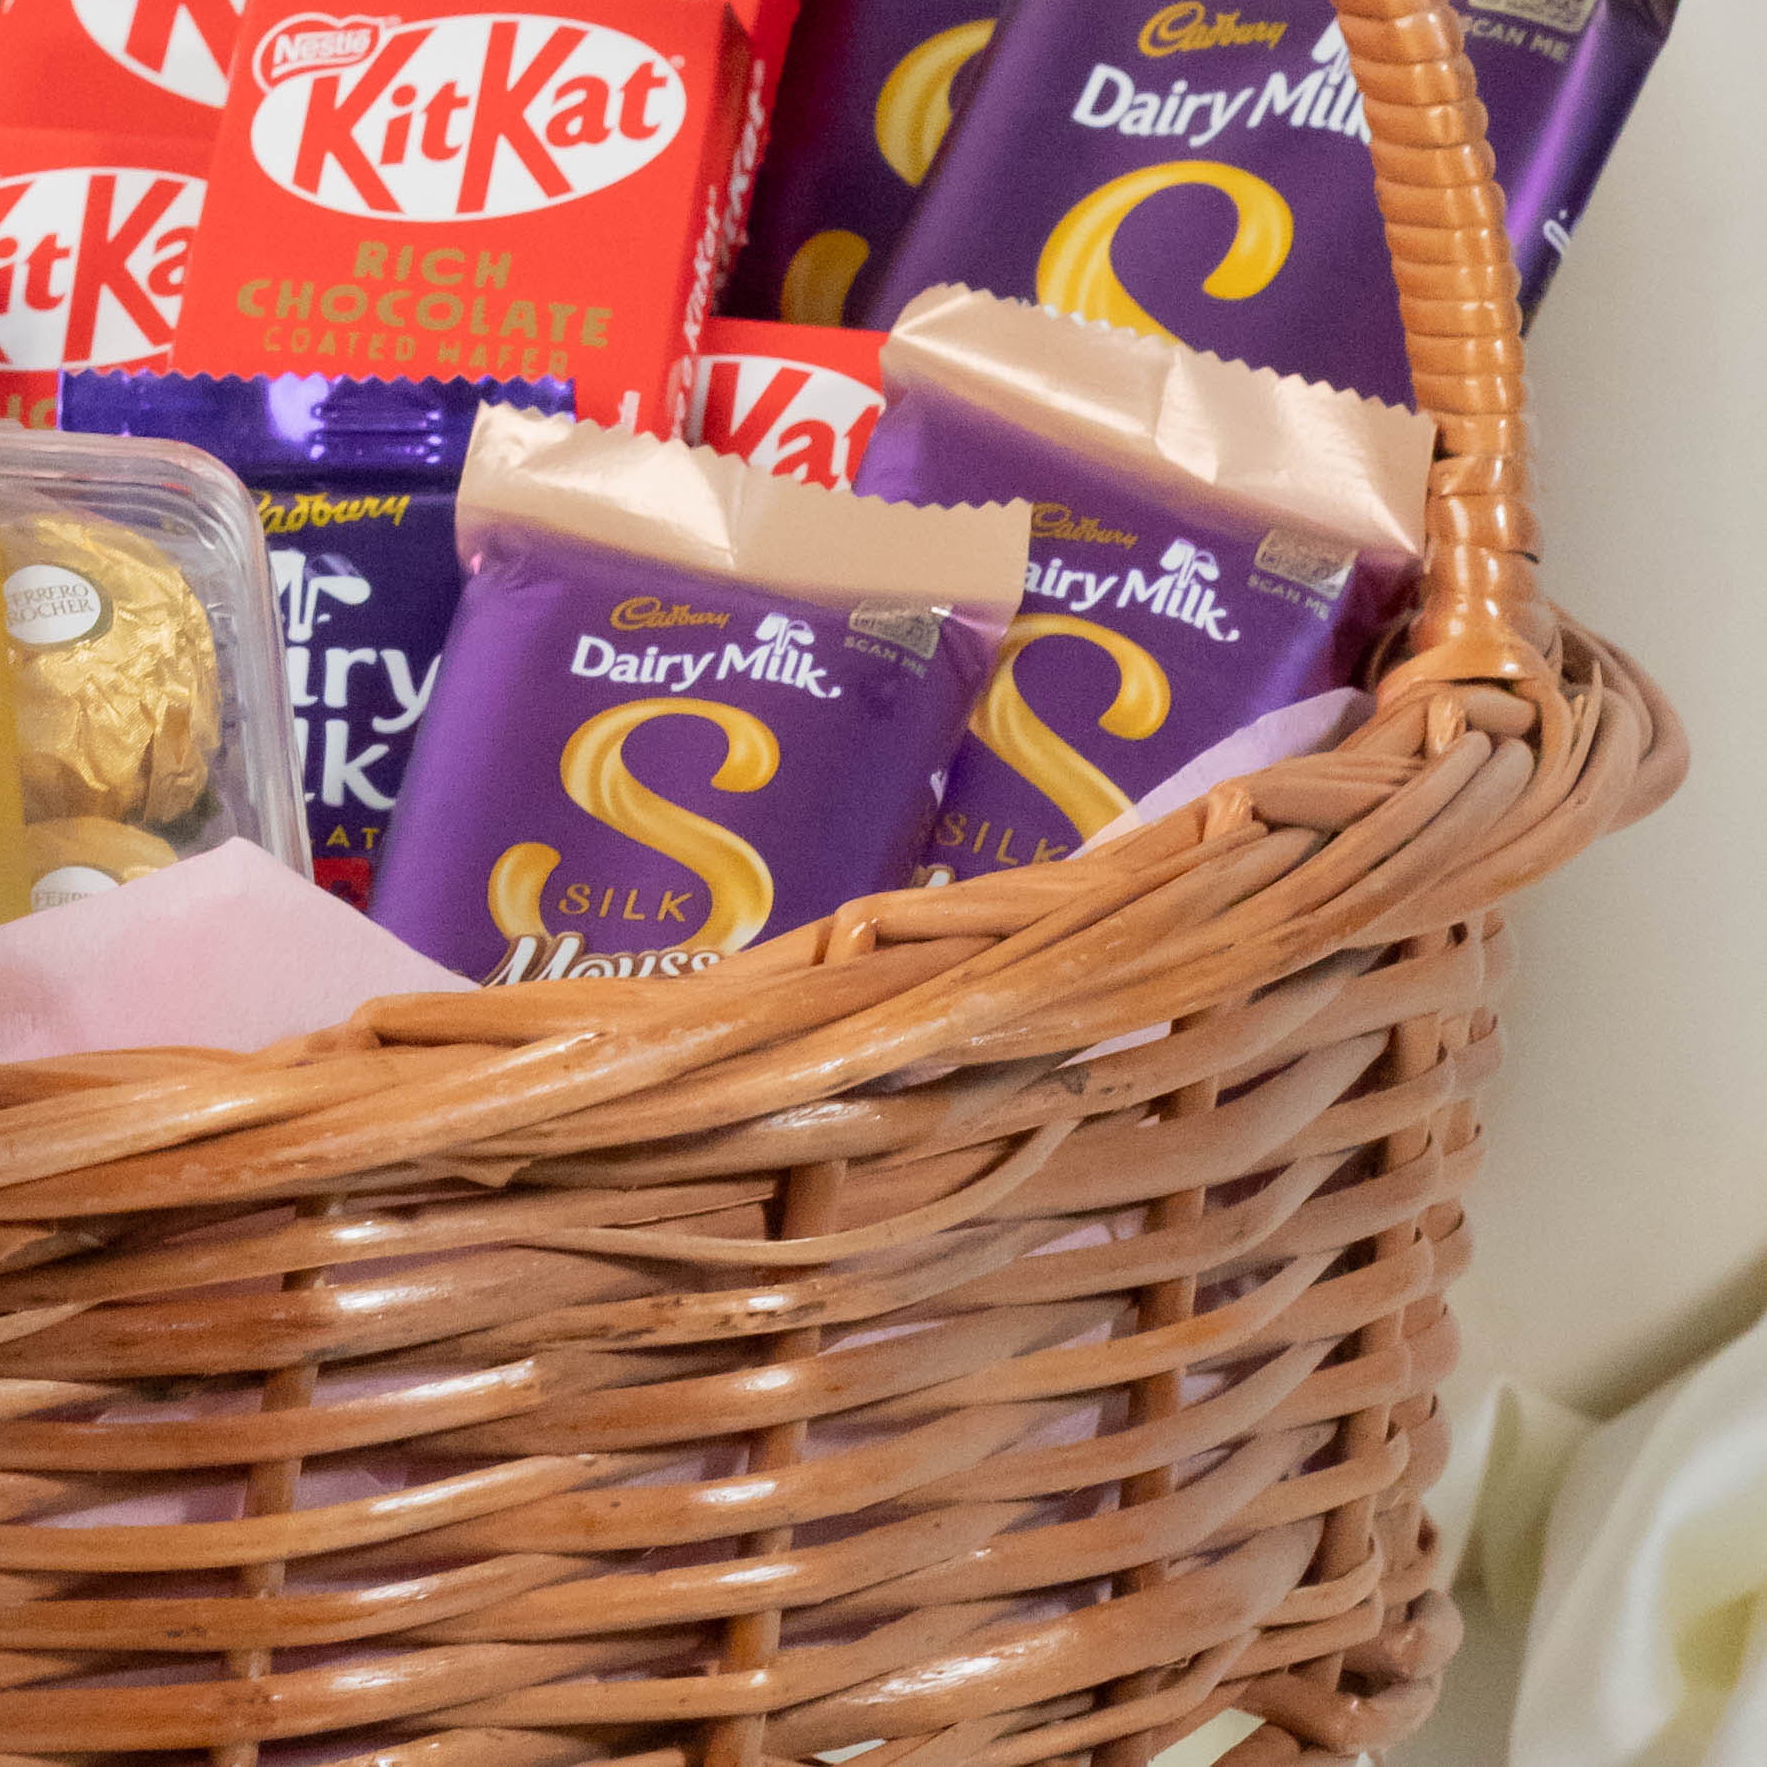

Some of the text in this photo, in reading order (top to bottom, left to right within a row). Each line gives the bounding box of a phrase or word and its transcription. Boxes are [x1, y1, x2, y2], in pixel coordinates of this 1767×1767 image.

[1138, 0, 1287, 57] Cadbury
[293, 20, 668, 214] KitKat
[1072, 64, 1254, 147] Dairy
[353, 241, 513, 290] RICH
[237, 279, 613, 347] CHOCOLATE
[263, 326, 569, 379] COATED WAFER
[10, 584, 89, 607] ERRERO
[609, 596, 730, 631] Cadbury
[1024, 557, 1240, 642] airy Milk
[570, 635, 842, 700] Dairy Milk
[558, 883, 692, 922] SILK
